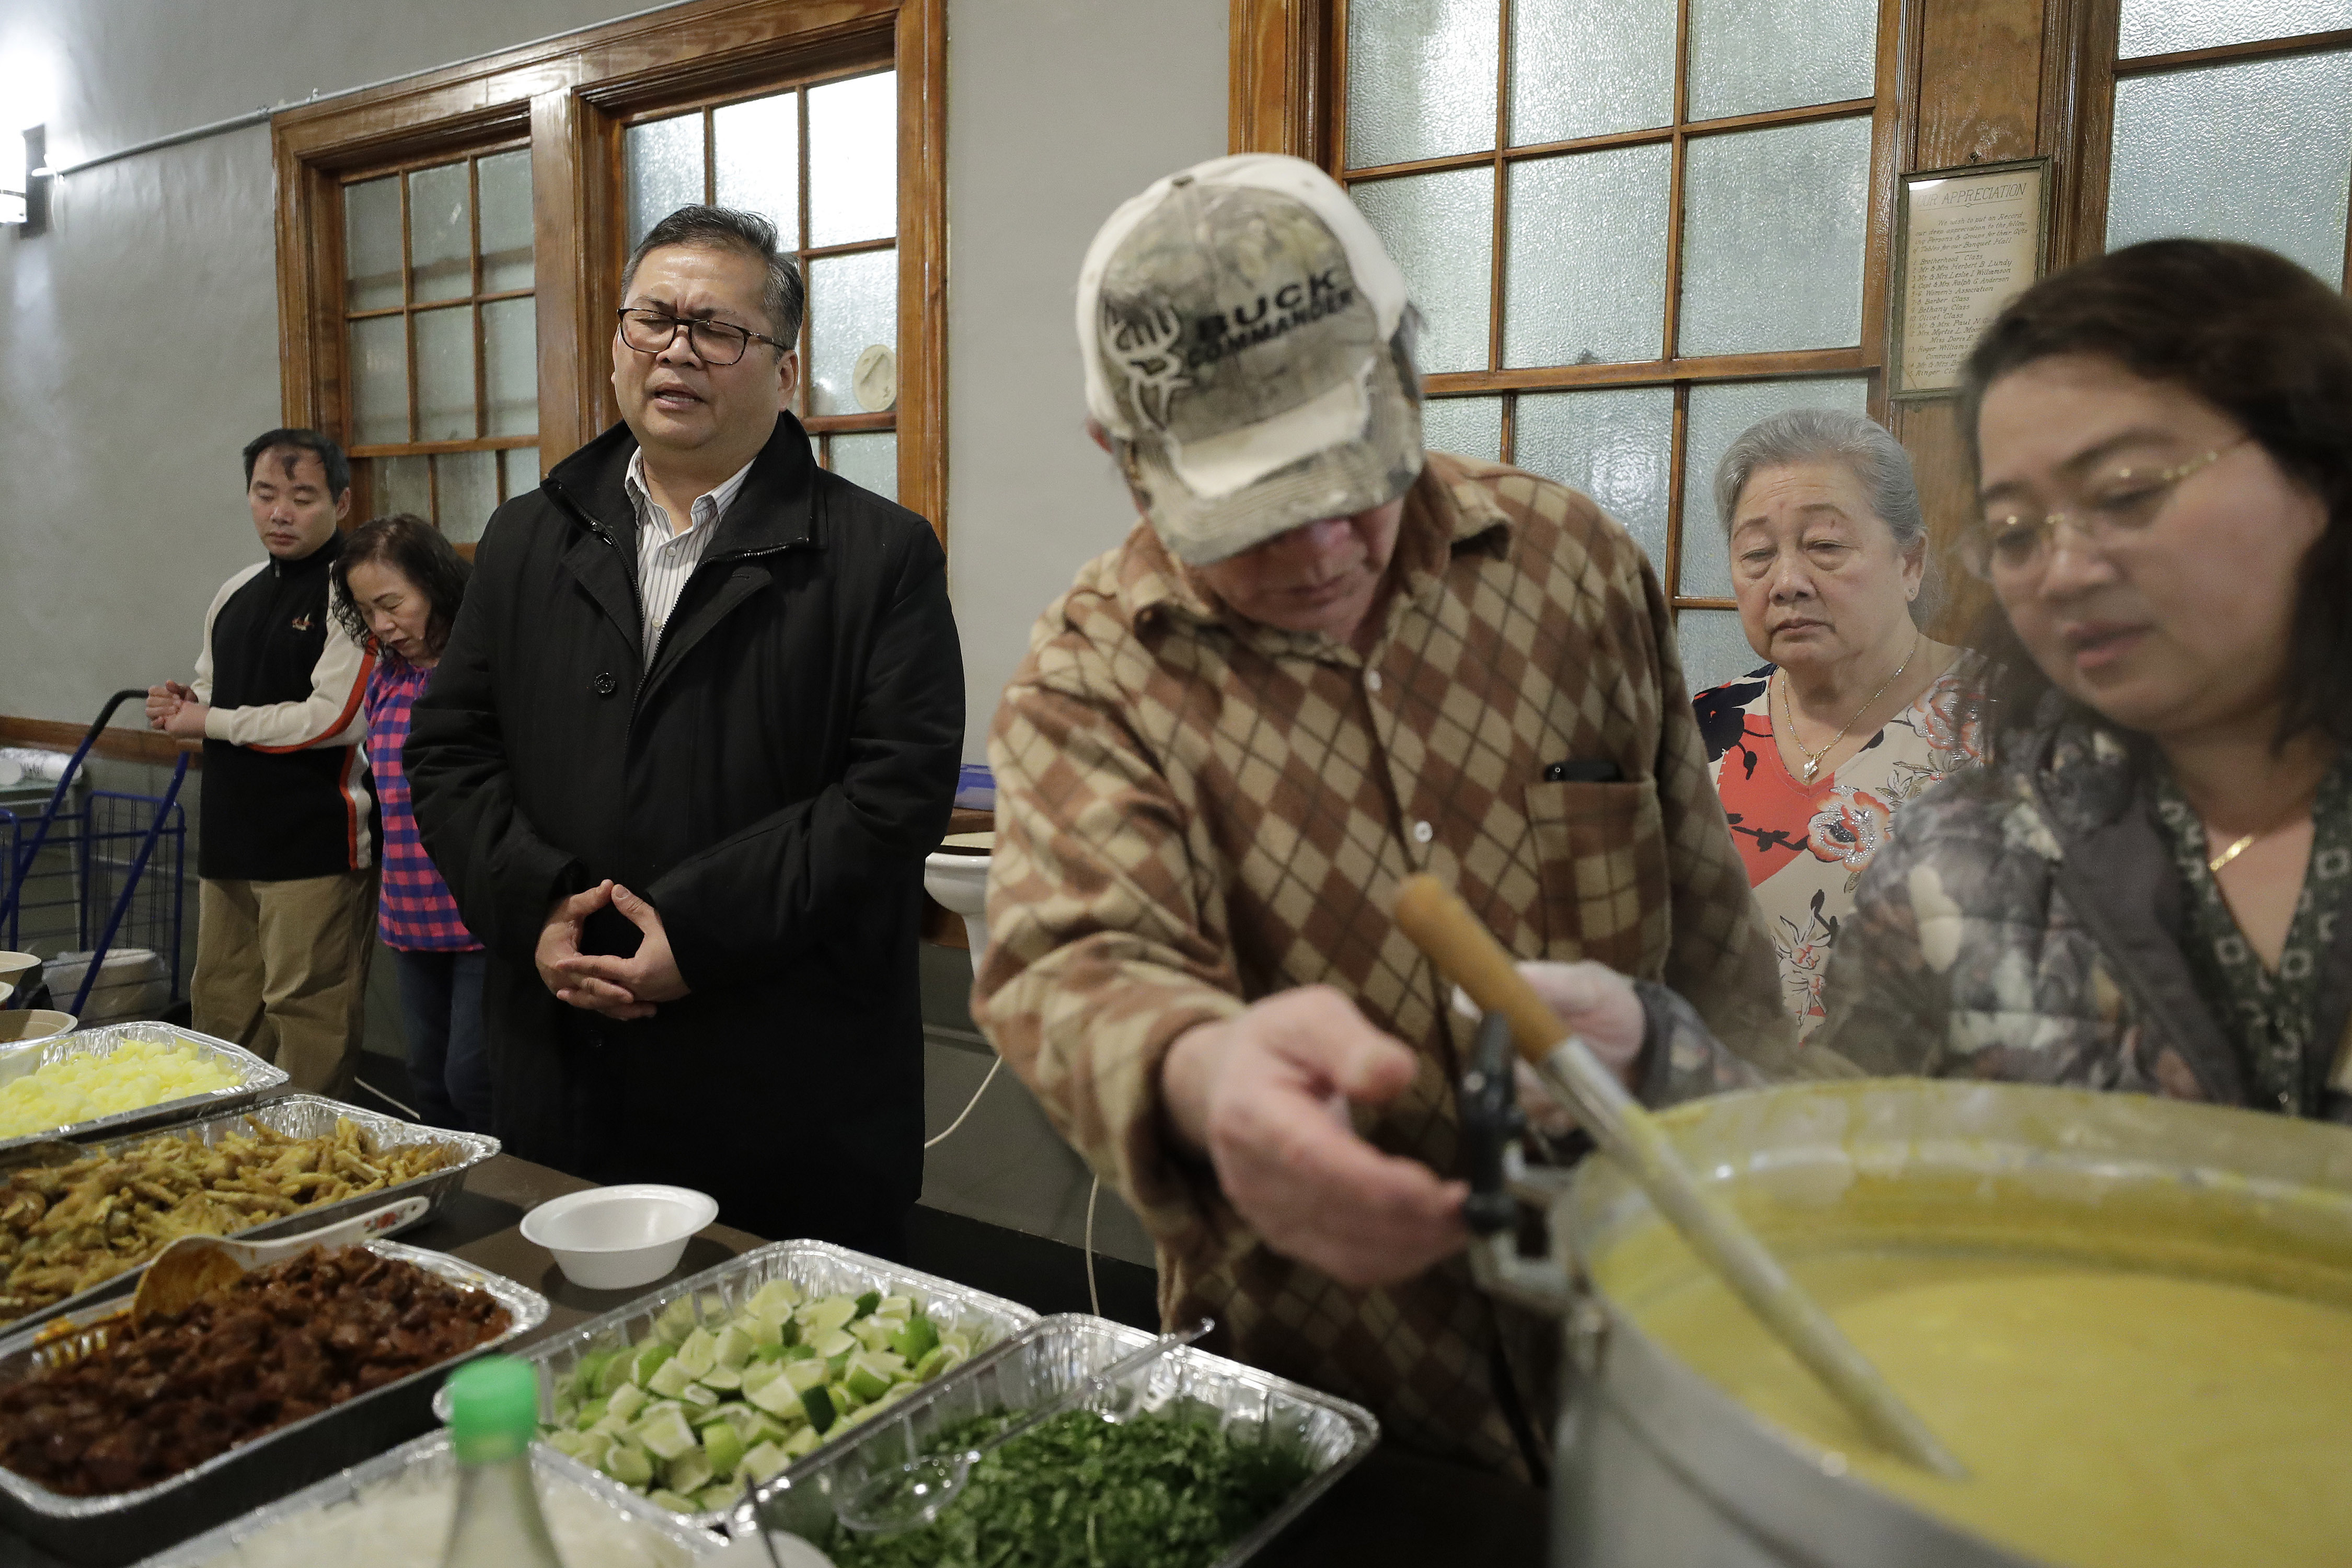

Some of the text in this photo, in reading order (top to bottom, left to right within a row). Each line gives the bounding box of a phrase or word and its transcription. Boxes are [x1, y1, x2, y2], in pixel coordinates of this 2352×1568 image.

[1917, 183, 2026, 207] OUR APPRECIATION
[1998, 212, 2023, 220] Record
[1946, 225, 1985, 234] appreciation
[2013, 227, 2028, 236] Gifts
[1963, 239, 1991, 248] Banquet
[1920, 256, 1959, 265] Brotherhood
[1988, 259, 2013, 267] Lundy
[1976, 268, 2011, 276] Williamson
[1955, 286, 1993, 294] Association
[1197, 269, 1336, 341] BUCK
[1918, 306, 1947, 314] Bethany
